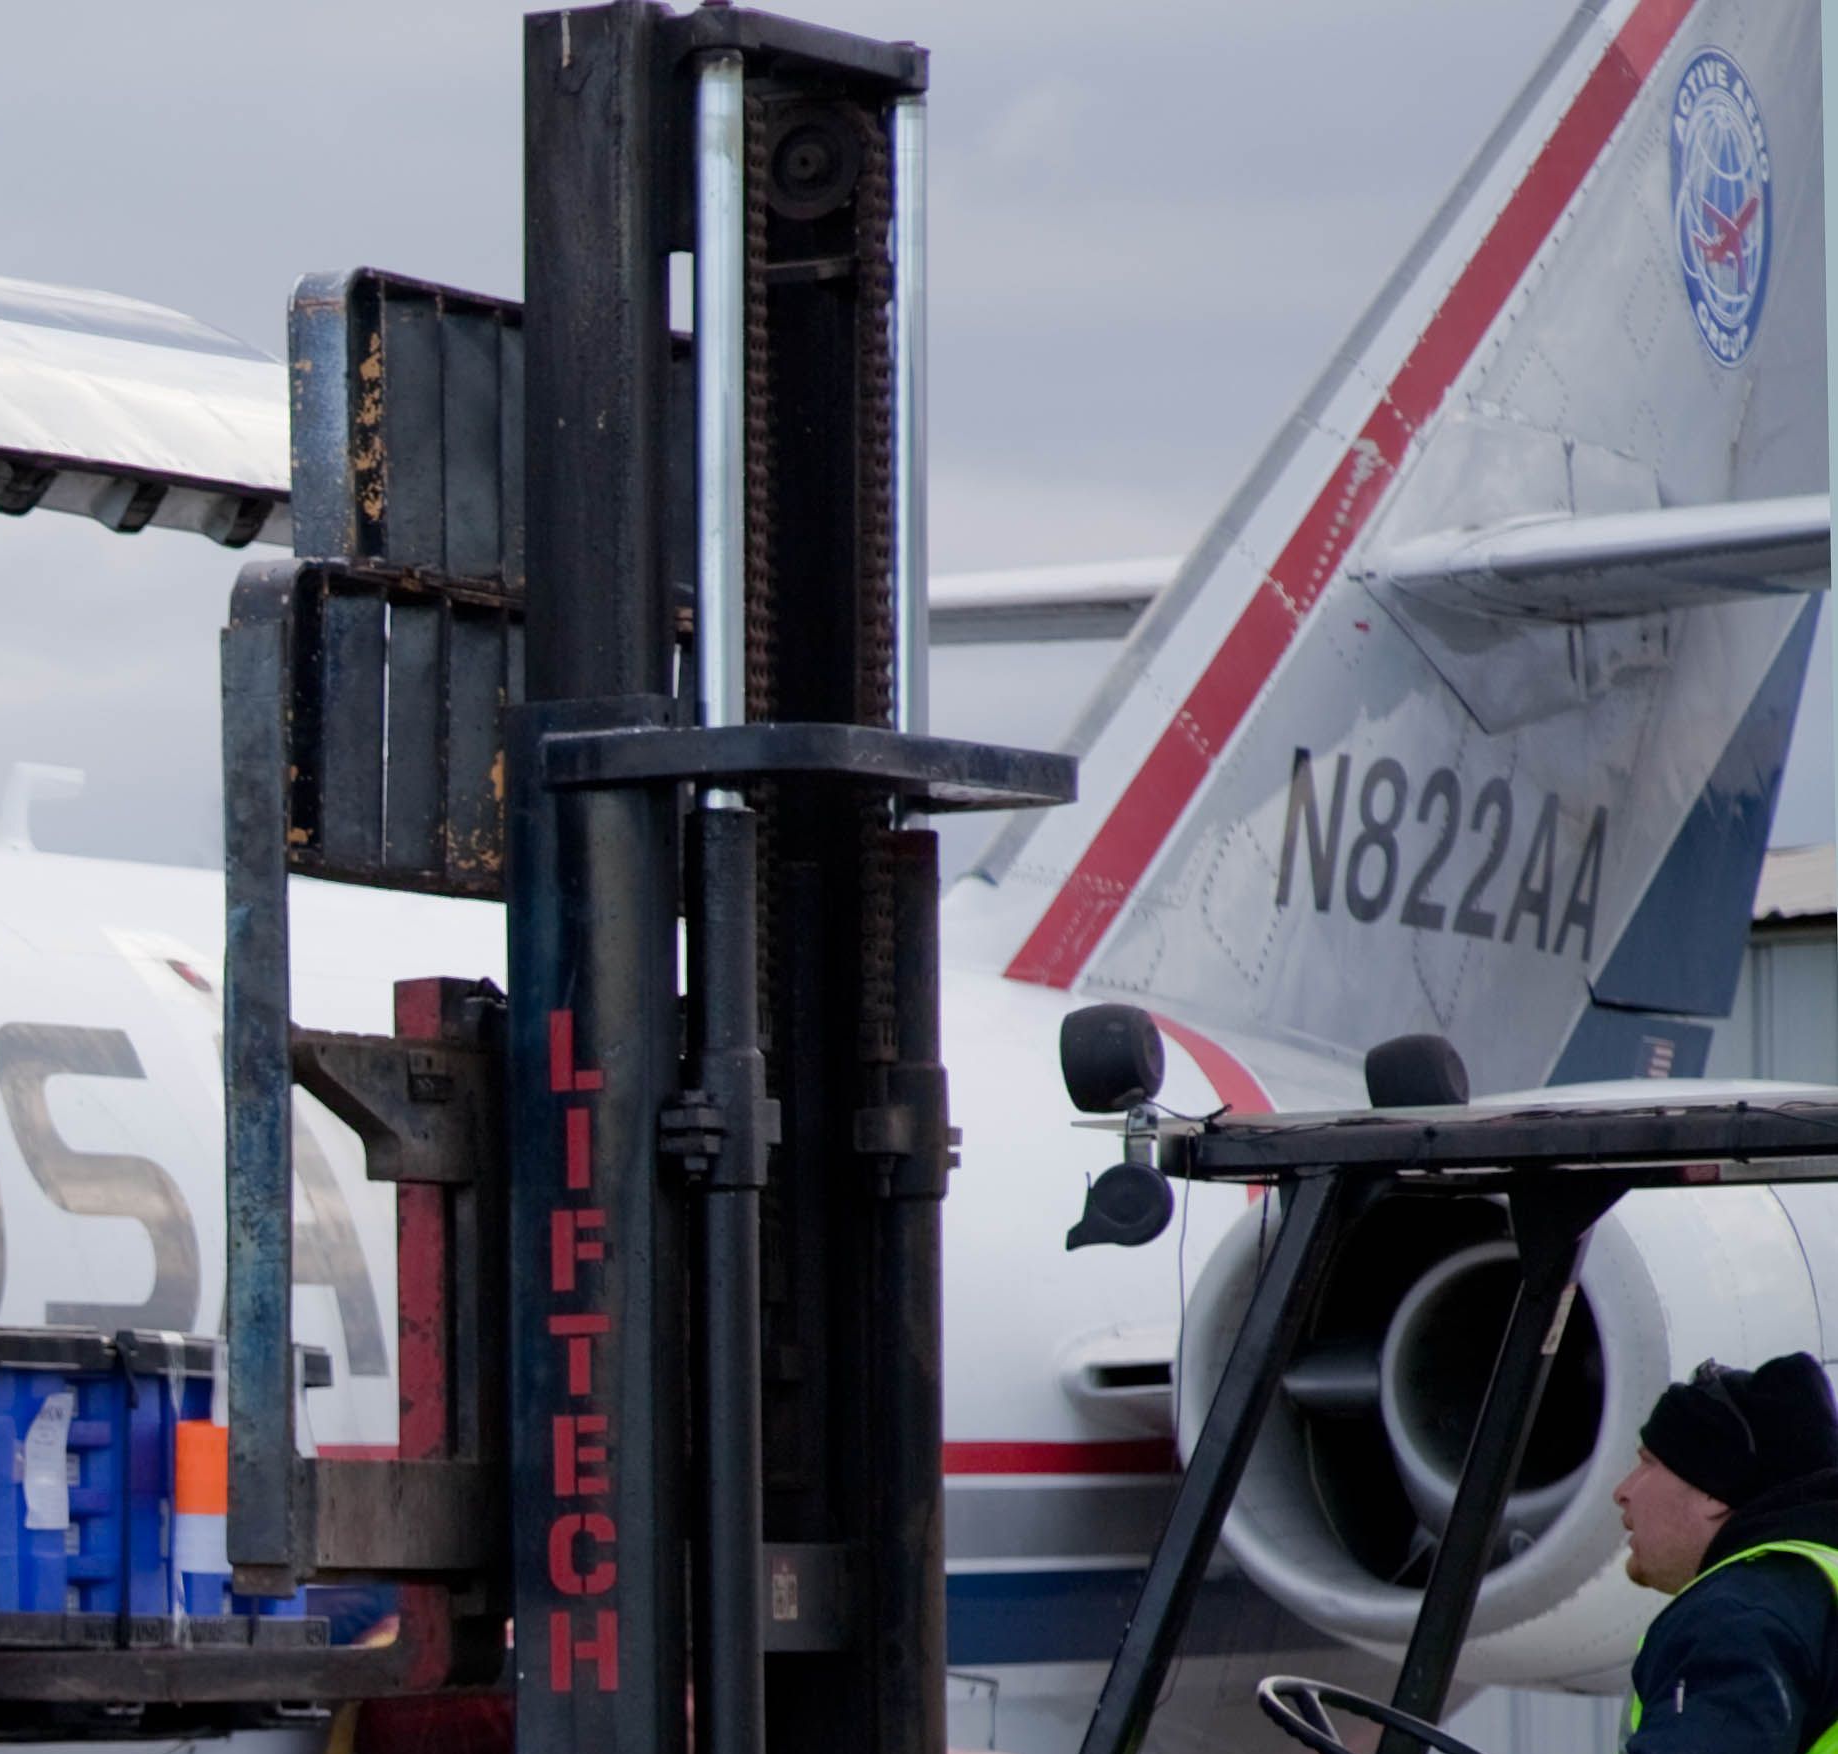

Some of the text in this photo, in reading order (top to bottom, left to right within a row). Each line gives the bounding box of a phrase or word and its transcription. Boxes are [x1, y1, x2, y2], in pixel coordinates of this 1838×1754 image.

[1673, 59, 1771, 183] ACTIVE AERO
[1698, 299, 1749, 361] GROUP
[1276, 746, 1609, 963] N822AA
[548, 1009, 620, 1693] LIFTECH
